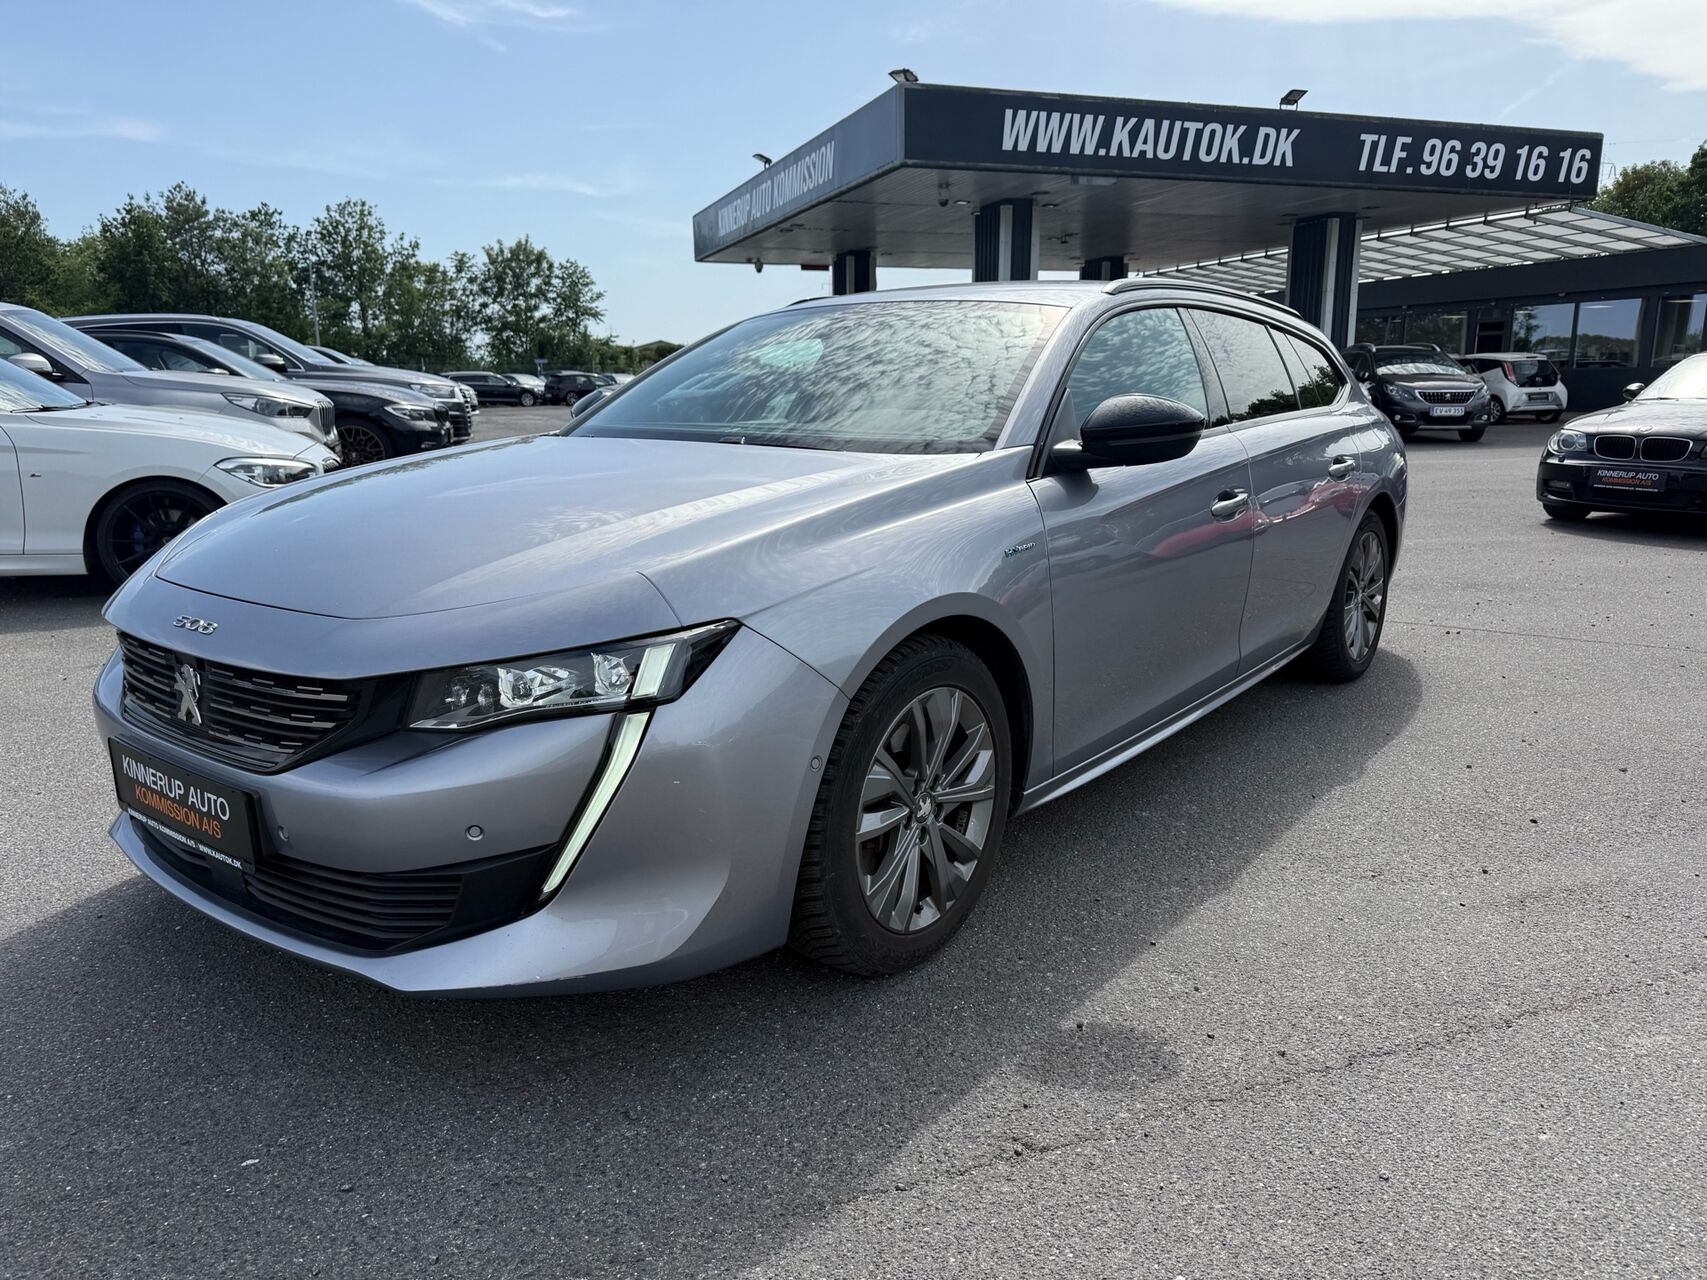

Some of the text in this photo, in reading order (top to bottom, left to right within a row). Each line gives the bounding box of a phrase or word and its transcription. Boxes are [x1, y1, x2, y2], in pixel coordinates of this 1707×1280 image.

[1002, 108, 1301, 167] WWW.KAUTOK.DK
[1358, 133, 1592, 185] TLF. 96 39 16 16
[718, 140, 835, 237] KINNERUP AUTO KOMMISSION
[1597, 469, 1659, 481] KINNERUP AUTO
[173, 615, 218, 635] 508
[122, 754, 230, 821] KINNERUP AUTO
[135, 784, 221, 839] KOMMISSION A/S
